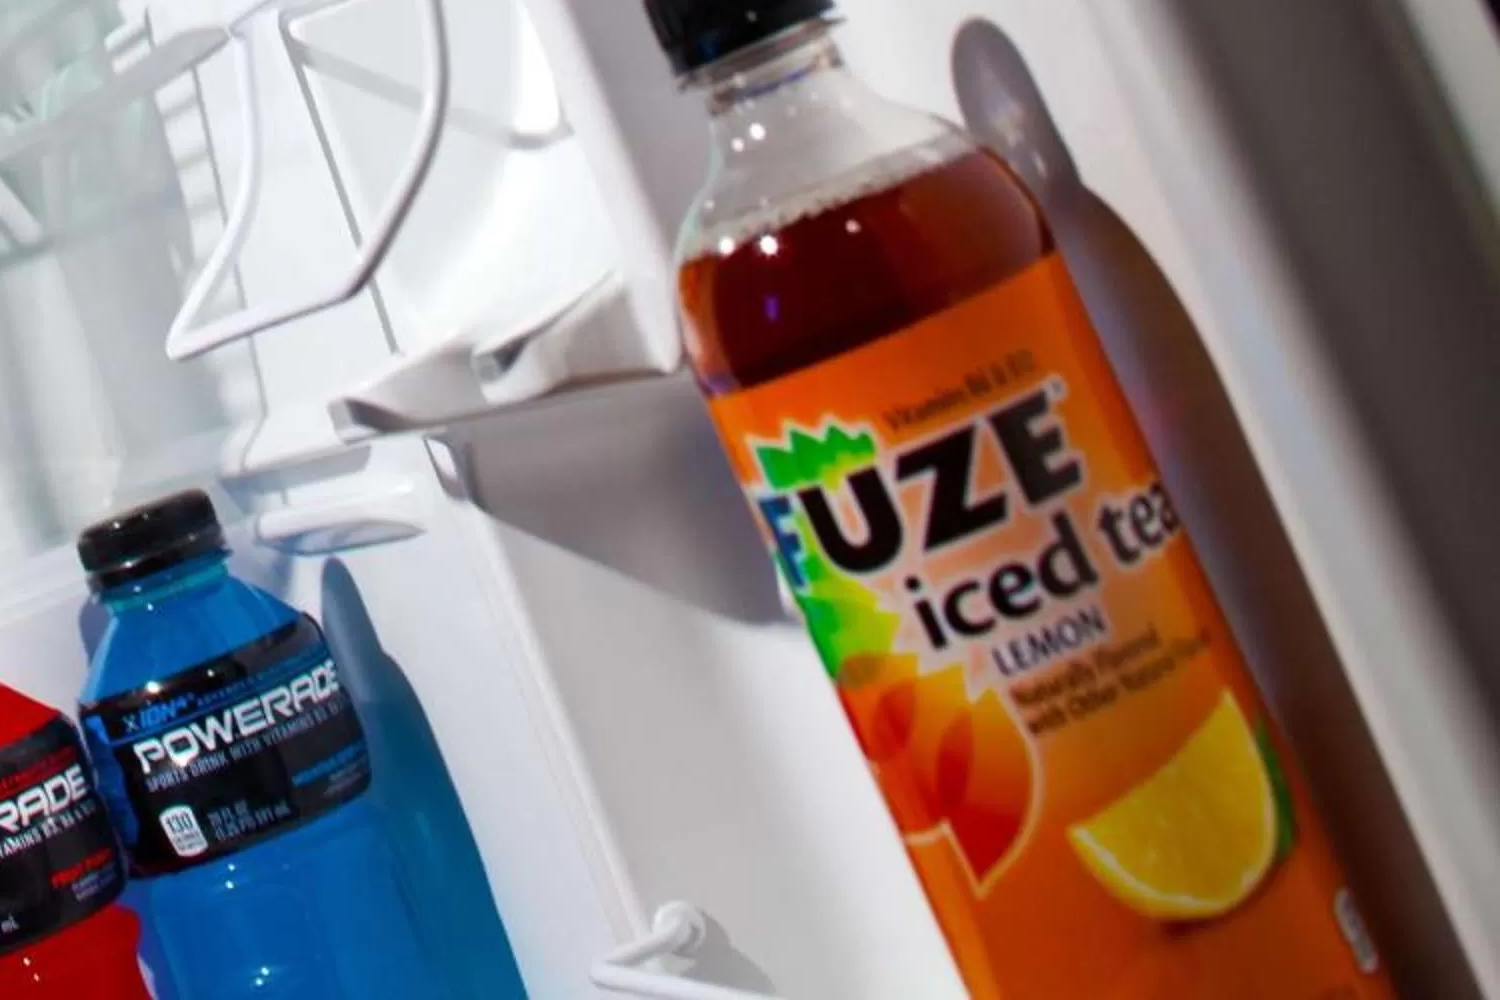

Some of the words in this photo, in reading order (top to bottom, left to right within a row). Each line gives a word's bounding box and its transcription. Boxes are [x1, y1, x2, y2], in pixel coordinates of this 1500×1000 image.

[758, 390, 1082, 589] FUZE
[905, 511, 1099, 650] iced
[991, 604, 1106, 677] LEMON
[132, 658, 340, 775] POWERADE
